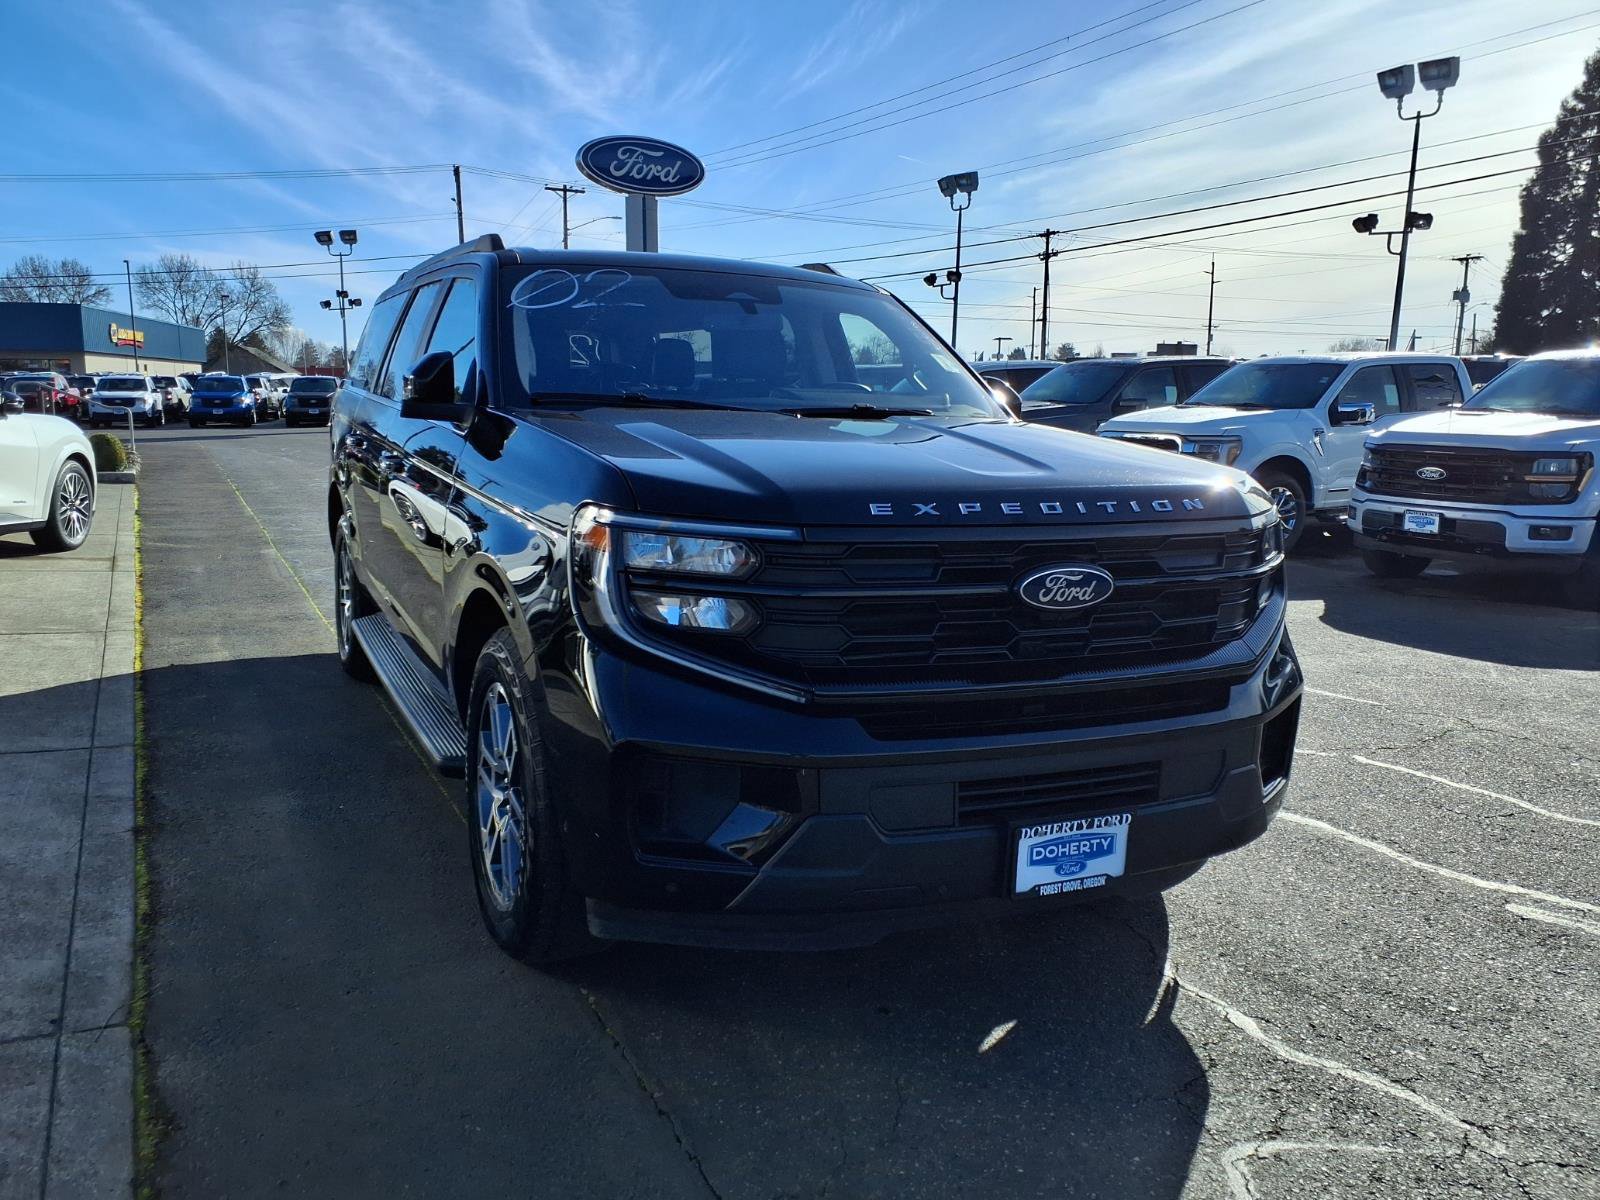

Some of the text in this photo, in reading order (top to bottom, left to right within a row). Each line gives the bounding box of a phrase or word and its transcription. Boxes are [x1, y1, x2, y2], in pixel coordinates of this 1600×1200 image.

[609, 146, 682, 183] Ford
[1421, 469, 1440, 477] Ford
[869, 498, 1205, 516] EXPEDITION
[1039, 574, 1097, 602] Ford
[1021, 814, 1132, 839] DOHERTY FORD
[1032, 837, 1112, 861] DOHERTY
[1060, 862, 1081, 874] Ford
[1040, 882, 1062, 896] FOREST
